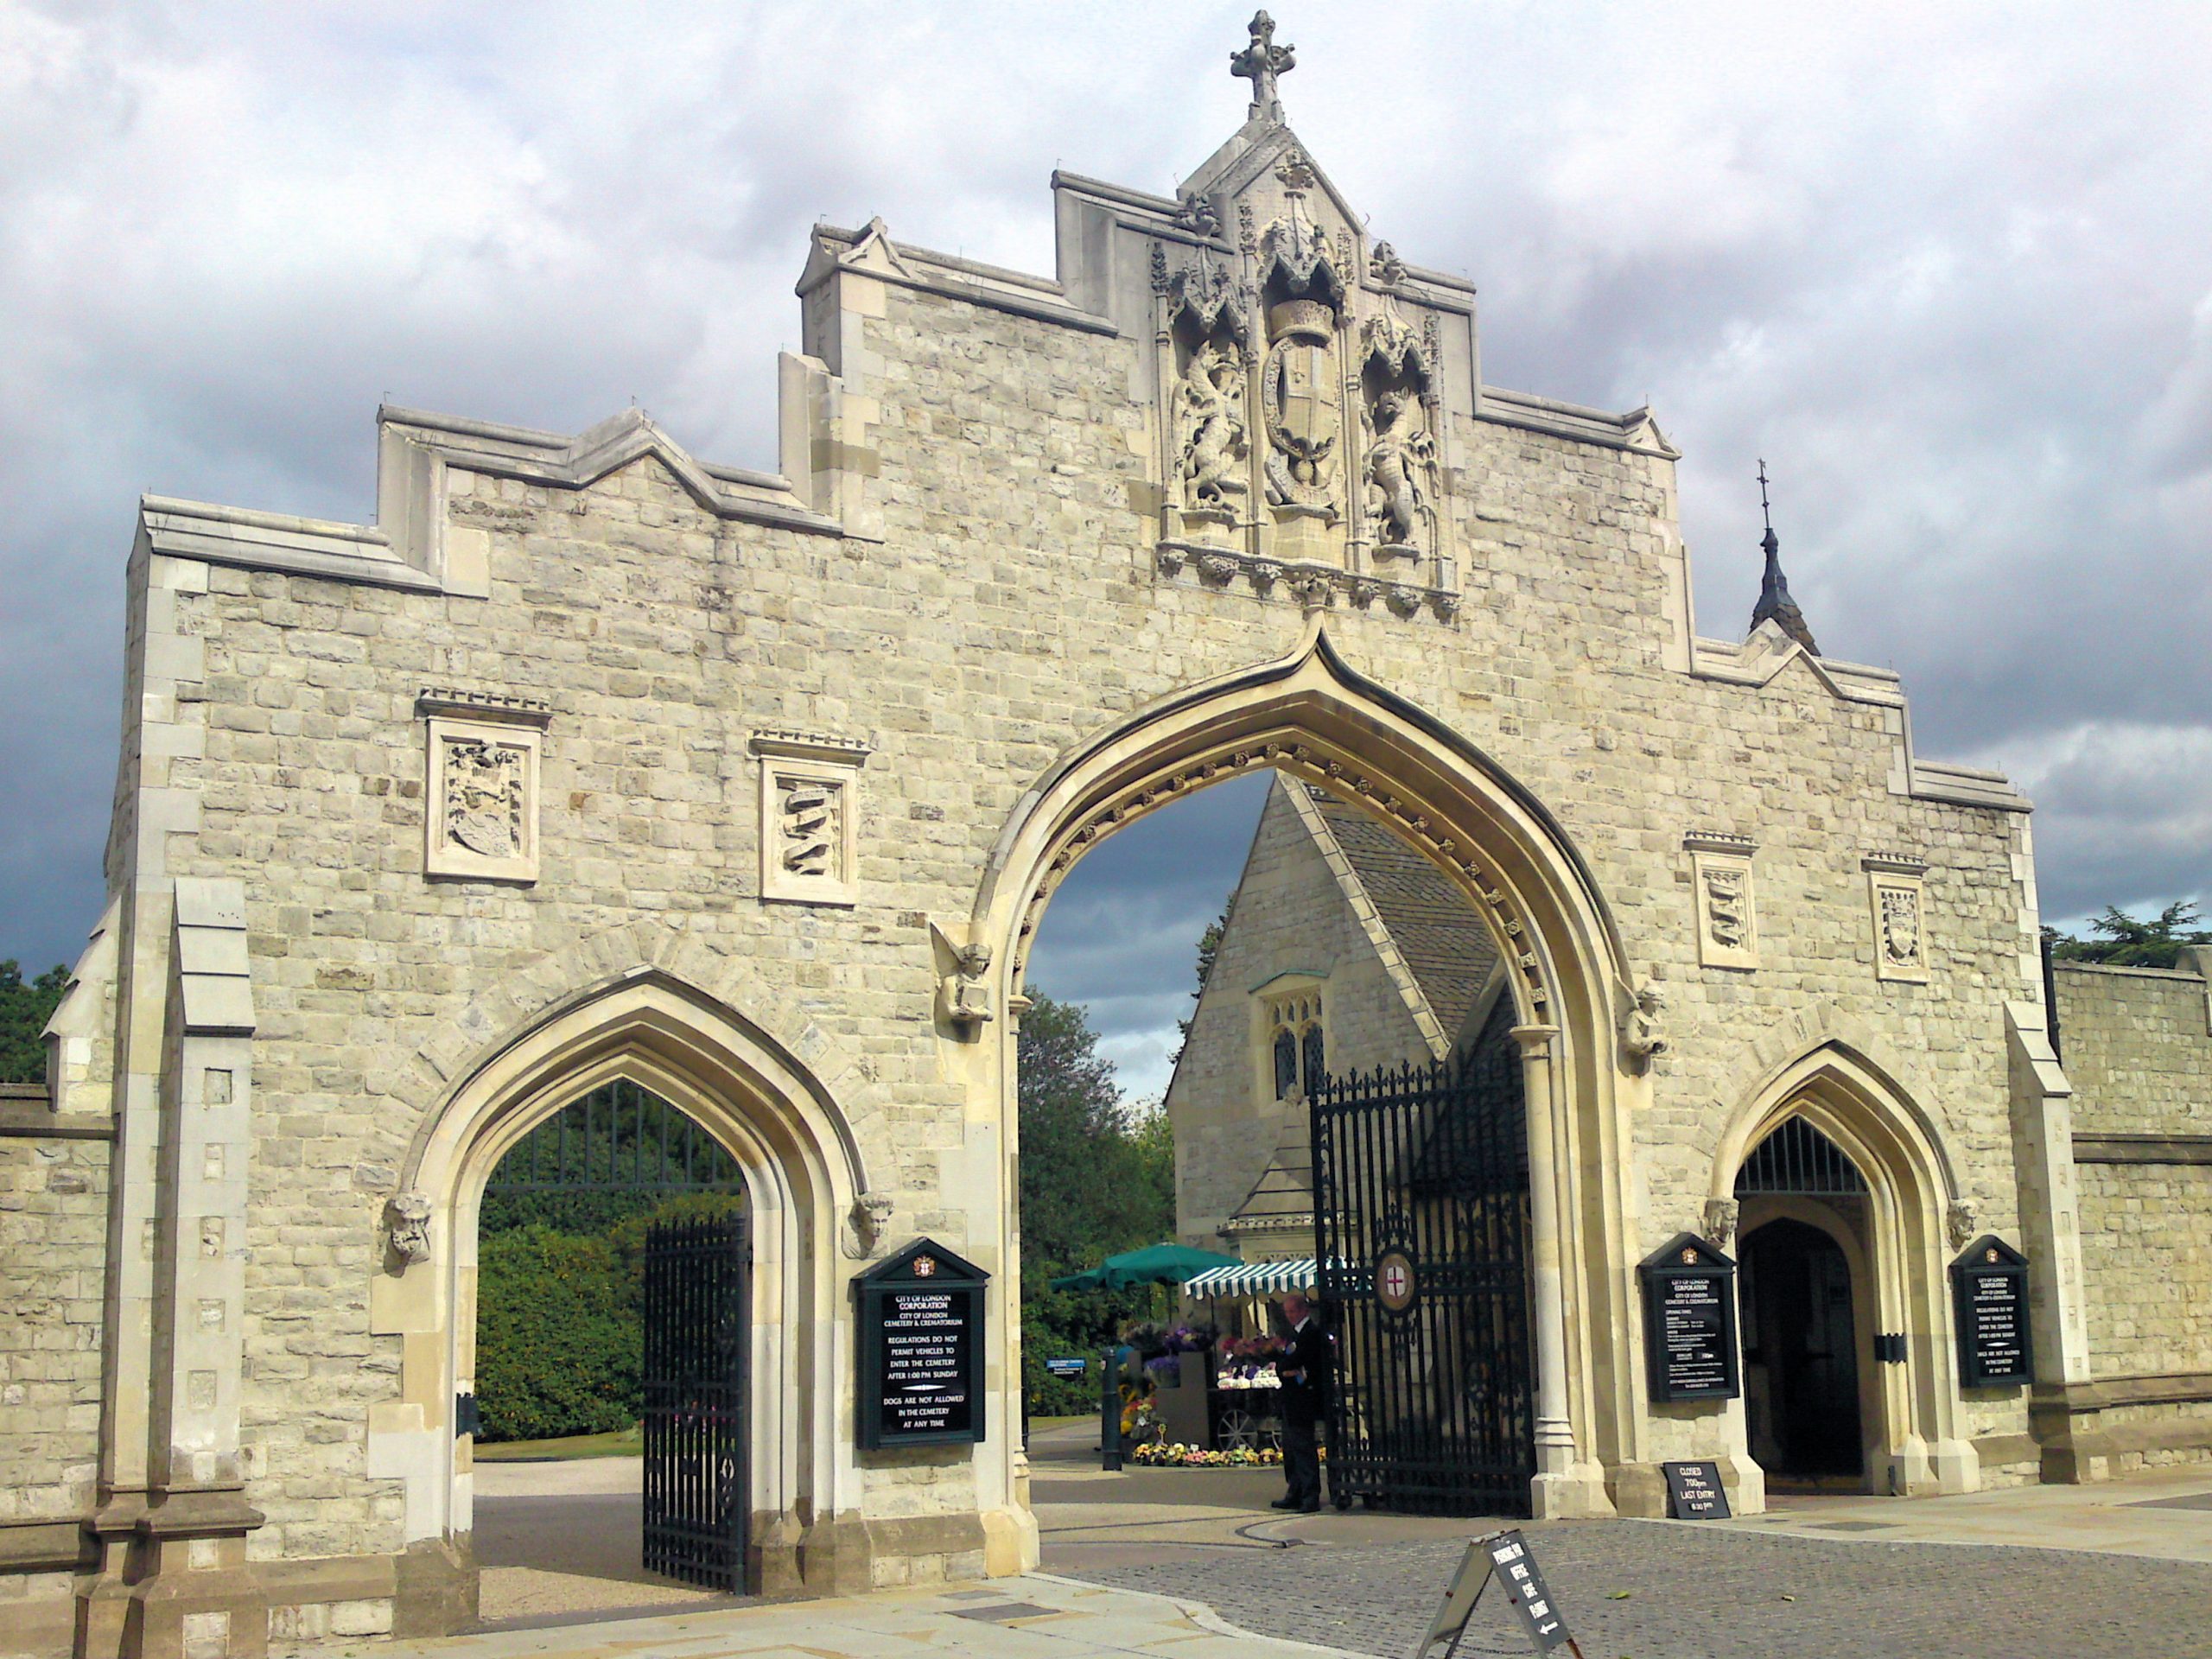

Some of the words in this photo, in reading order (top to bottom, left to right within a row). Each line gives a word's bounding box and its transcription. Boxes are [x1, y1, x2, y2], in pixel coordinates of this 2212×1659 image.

[1680, 1467, 1702, 1476] CLOSED
[1681, 1491, 1696, 1499] LAST
[1697, 1490, 1715, 1499] ENTRY
